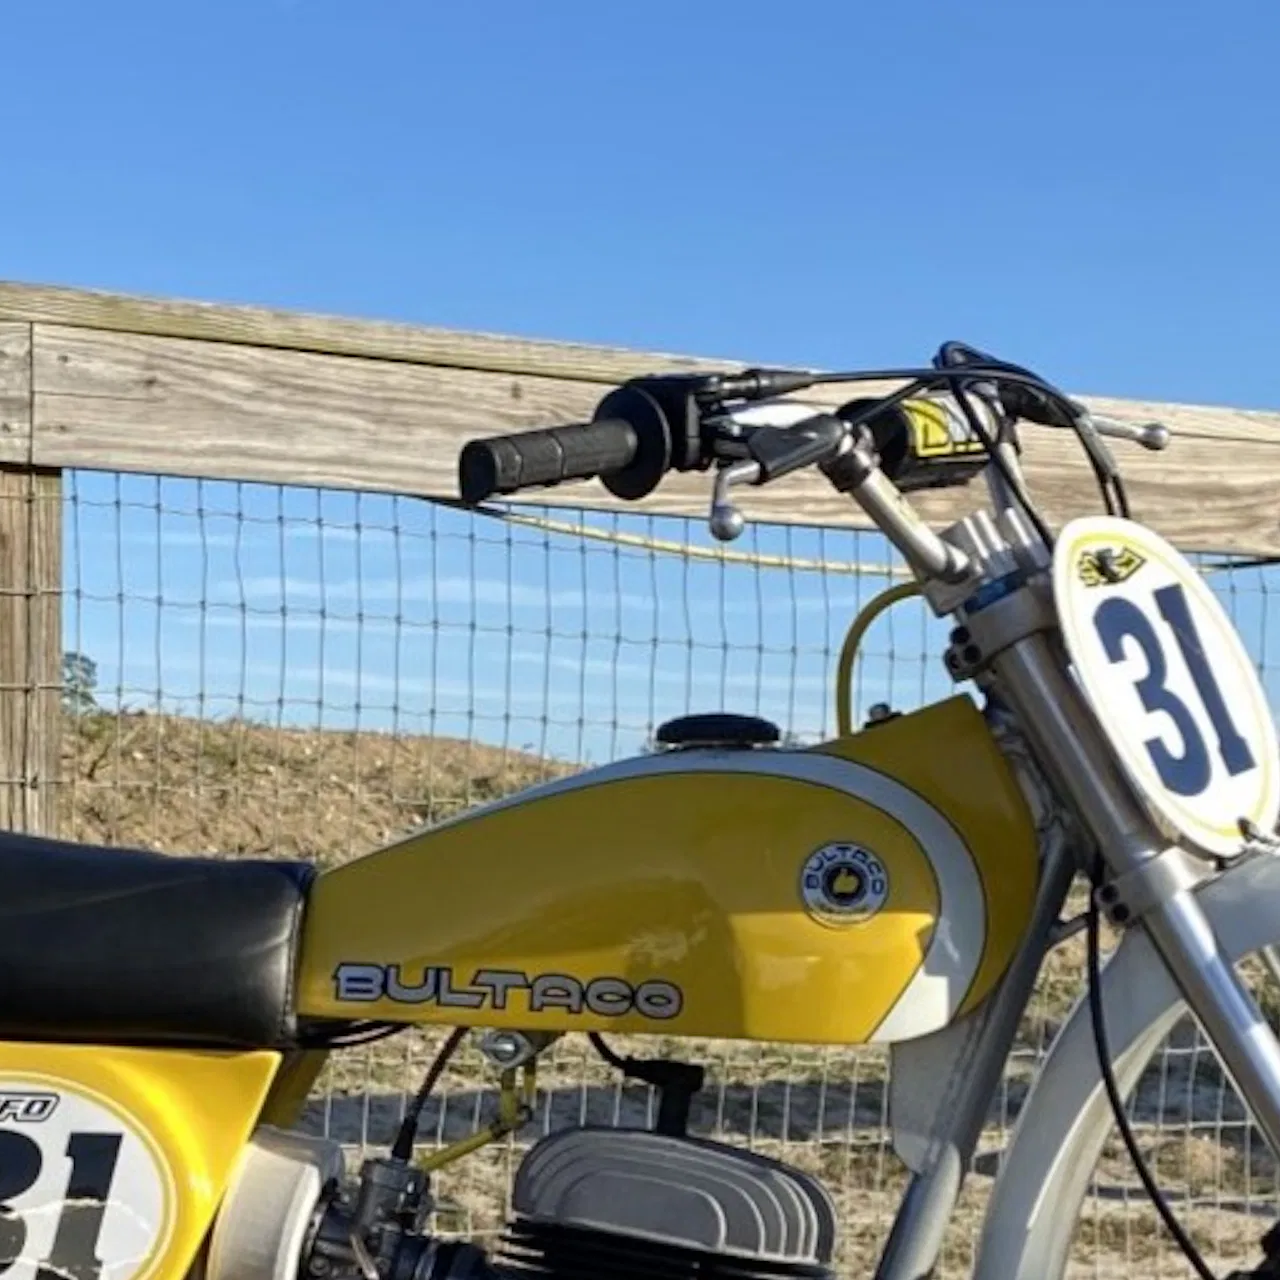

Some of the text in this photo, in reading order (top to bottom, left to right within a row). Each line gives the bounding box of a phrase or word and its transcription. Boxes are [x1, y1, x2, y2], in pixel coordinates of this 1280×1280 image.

[1093, 583, 1257, 797] 31
[805, 845, 885, 895] BULTACO
[334, 961, 684, 1020] BULTACO
